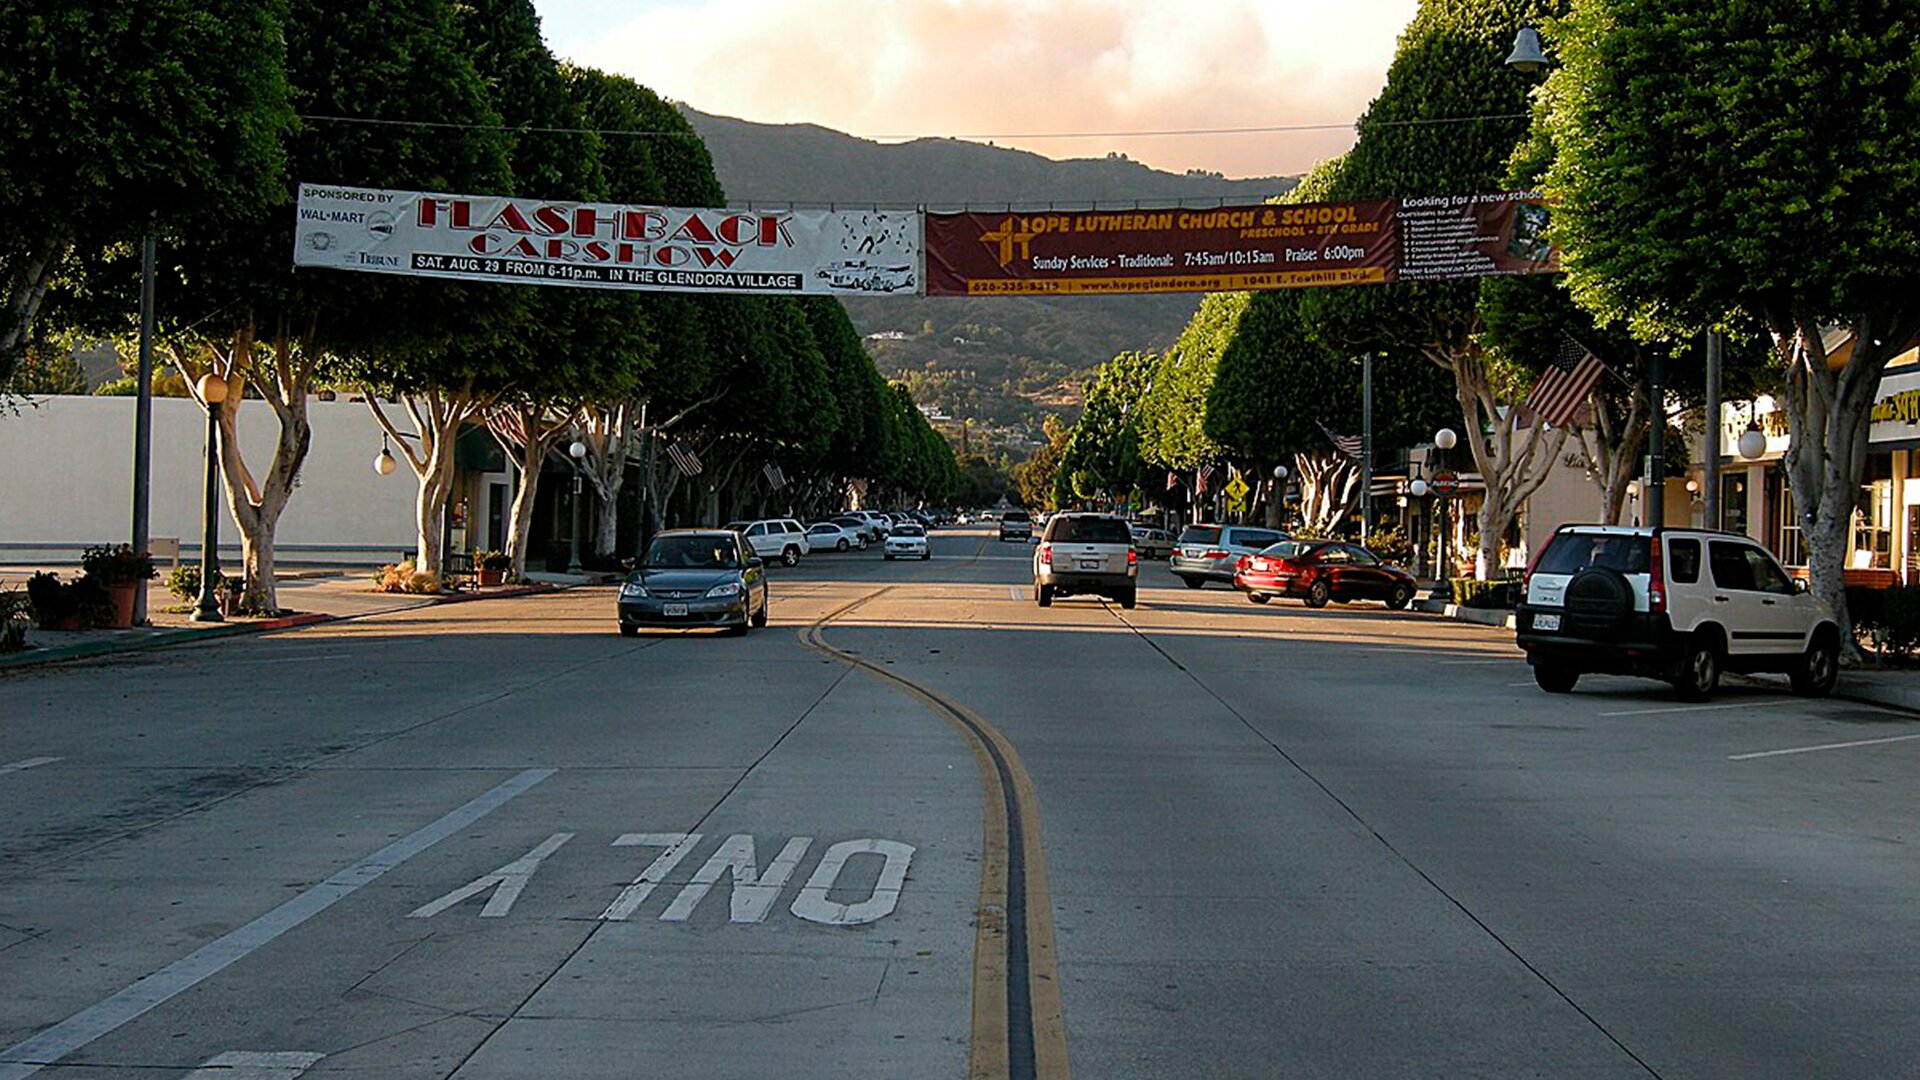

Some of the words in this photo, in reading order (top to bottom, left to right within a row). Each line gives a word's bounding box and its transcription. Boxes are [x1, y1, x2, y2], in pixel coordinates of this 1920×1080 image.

[303, 188, 375, 202] SPONSORED
[377, 194, 394, 203] BY
[1402, 195, 1449, 209] Looking
[1452, 194, 1469, 205] for
[1470, 194, 1479, 204] a
[1480, 192, 1507, 203] new
[1508, 190, 1543, 201] schoo
[417, 198, 796, 248] FLASHBACK
[1074, 213, 1173, 232] LUTHERAN
[1178, 210, 1255, 229] CHURCH
[1261, 209, 1277, 226] &
[1281, 205, 1358, 225] SCHOOL
[1239, 223, 1305, 239] PRESCHOOL
[1340, 222, 1379, 234] GRADE
[416, 255, 445, 270] SAT.
[449, 258, 481, 272] AUG.
[485, 260, 500, 273] 29
[505, 261, 545, 276] FROM
[548, 265, 601, 281] 6-11p.m.
[609, 268, 623, 281] IN
[627, 269, 654, 283] THE
[657, 271, 737, 287] GLENDORA
[737, 275, 797, 288] VILLAGE
[1033, 255, 1068, 272] Sunday
[1070, 253, 1109, 269] Services
[1118, 253, 1174, 268] Traditional:
[1184, 251, 1275, 267] 7:45am/10:15am
[1285, 247, 1318, 263] Praise:
[1324, 245, 1365, 261] 6:00pm
[1290, 272, 1336, 284] Foothill
[1340, 270, 1371, 281] Blvd.
[404, 831, 918, 926] ONLY
